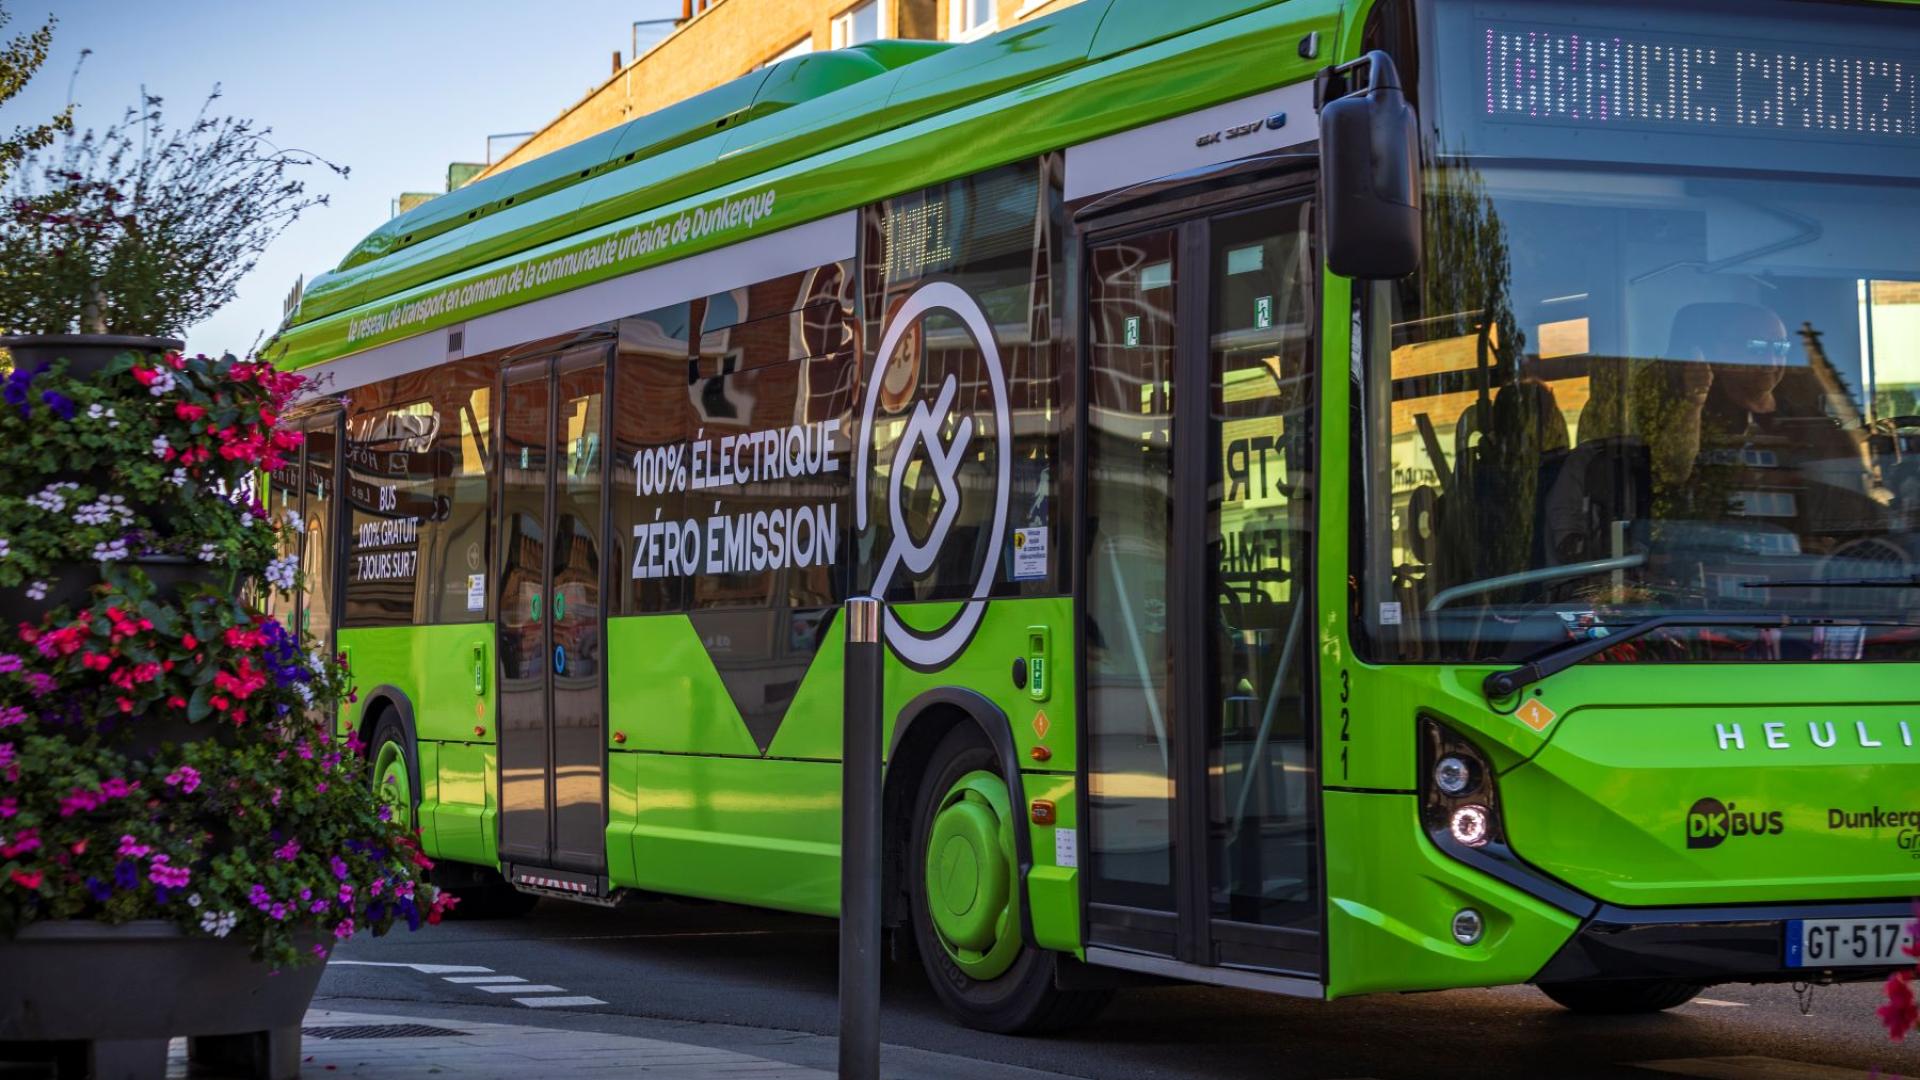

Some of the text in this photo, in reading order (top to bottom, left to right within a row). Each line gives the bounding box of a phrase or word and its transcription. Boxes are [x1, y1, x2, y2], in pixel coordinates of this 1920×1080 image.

[357, 311, 388, 340] réseau
[388, 303, 402, 329] de
[401, 293, 447, 326] transport
[446, 288, 460, 312] en
[460, 273, 508, 307] commun
[508, 265, 524, 292] de
[524, 260, 536, 288] la
[535, 231, 618, 282] communauté
[618, 219, 671, 261] urbaine
[672, 211, 690, 245] de
[691, 188, 776, 239] Dunkerque
[633, 418, 841, 497] 100% ÉLECTRIQUE
[379, 485, 397, 512] BUS
[358, 516, 419, 549] 100% GRATUIT
[632, 500, 838, 580] ZÉRO ÉMISSION
[357, 550, 418, 581] 7 JOURS SUR 7
[1714, 719, 1914, 751] HEULI
[1828, 806, 1920, 831] Dunkerq
[1897, 828, 1920, 849] Gr
[1808, 924, 1919, 960] GT-517-
